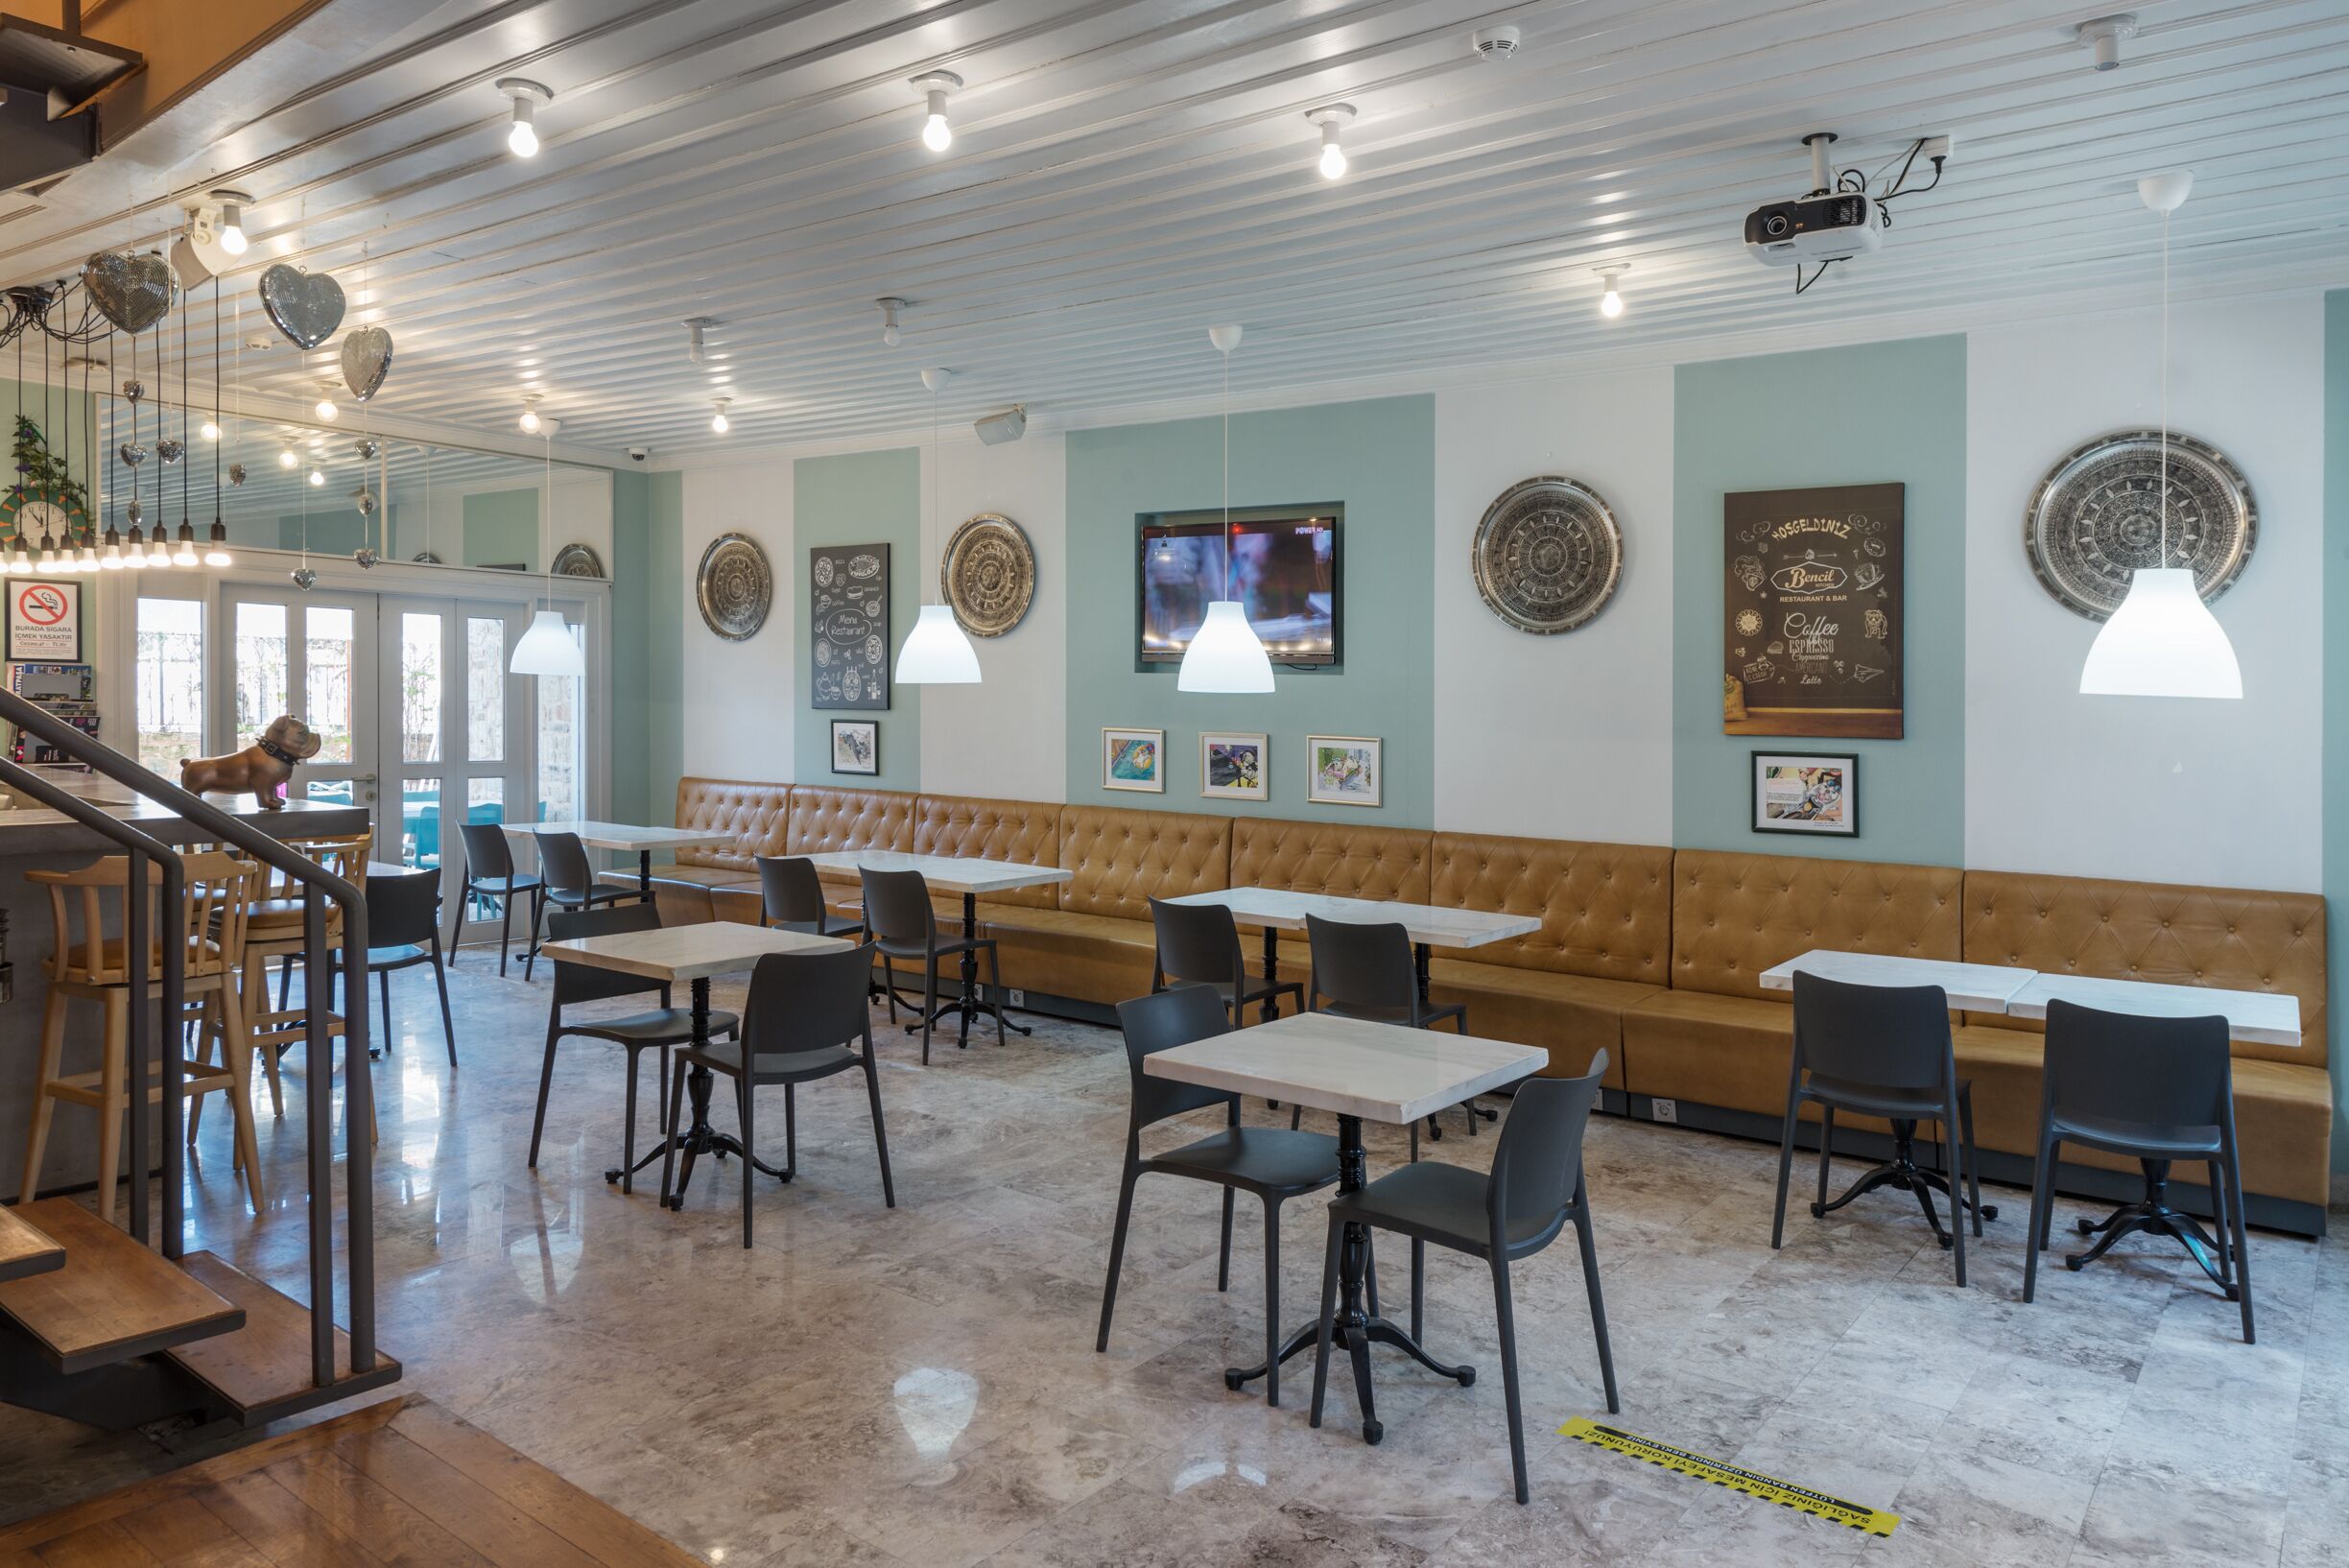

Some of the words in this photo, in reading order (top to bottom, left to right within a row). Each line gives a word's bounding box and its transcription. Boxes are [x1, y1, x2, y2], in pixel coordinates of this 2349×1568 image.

[1785, 568, 1835, 588] Bencil
[838, 614, 858, 625] Menu
[1784, 611, 1839, 644] Coffee
[831, 626, 866, 636] Restaurant
[1789, 639, 1835, 653] ESPRESSO
[1625, 1435, 1687, 1458] BEKLEYİNİZ
[1674, 1459, 1746, 1485] MESAFEYİ
[1688, 1453, 1743, 1476] ÜZERİNDE
[1745, 1472, 1787, 1489] BANDIN
[1750, 1482, 1779, 1496] İÇİN
[1791, 1485, 1835, 1504] LÜTFEN
[1782, 1493, 1871, 1524] SAĞLIĞINIZ
